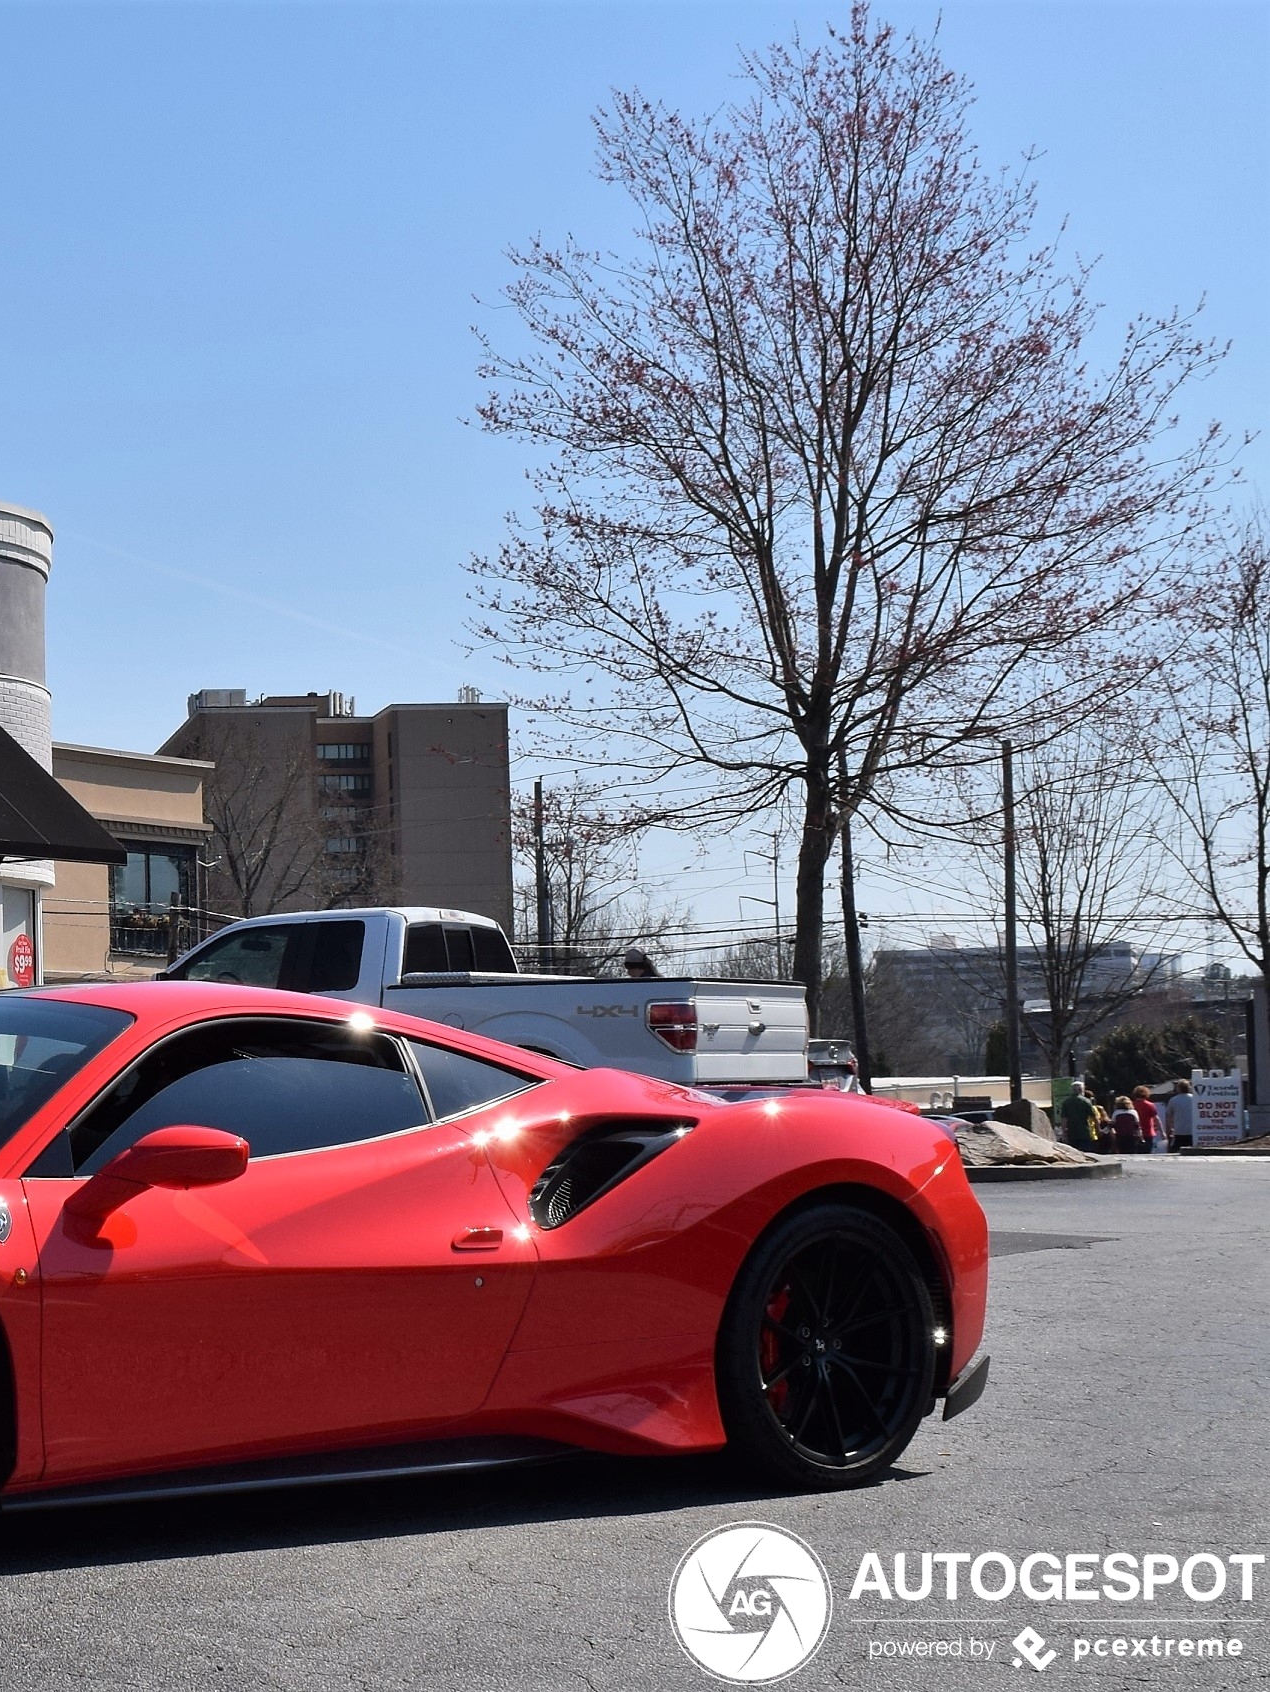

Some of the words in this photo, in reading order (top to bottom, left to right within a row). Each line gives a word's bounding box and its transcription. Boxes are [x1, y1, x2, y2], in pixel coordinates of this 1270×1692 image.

[1197, 1102, 1213, 1110] DO
[1215, 1101, 1238, 1110] NOT
[1199, 1110, 1235, 1119] BLOCK
